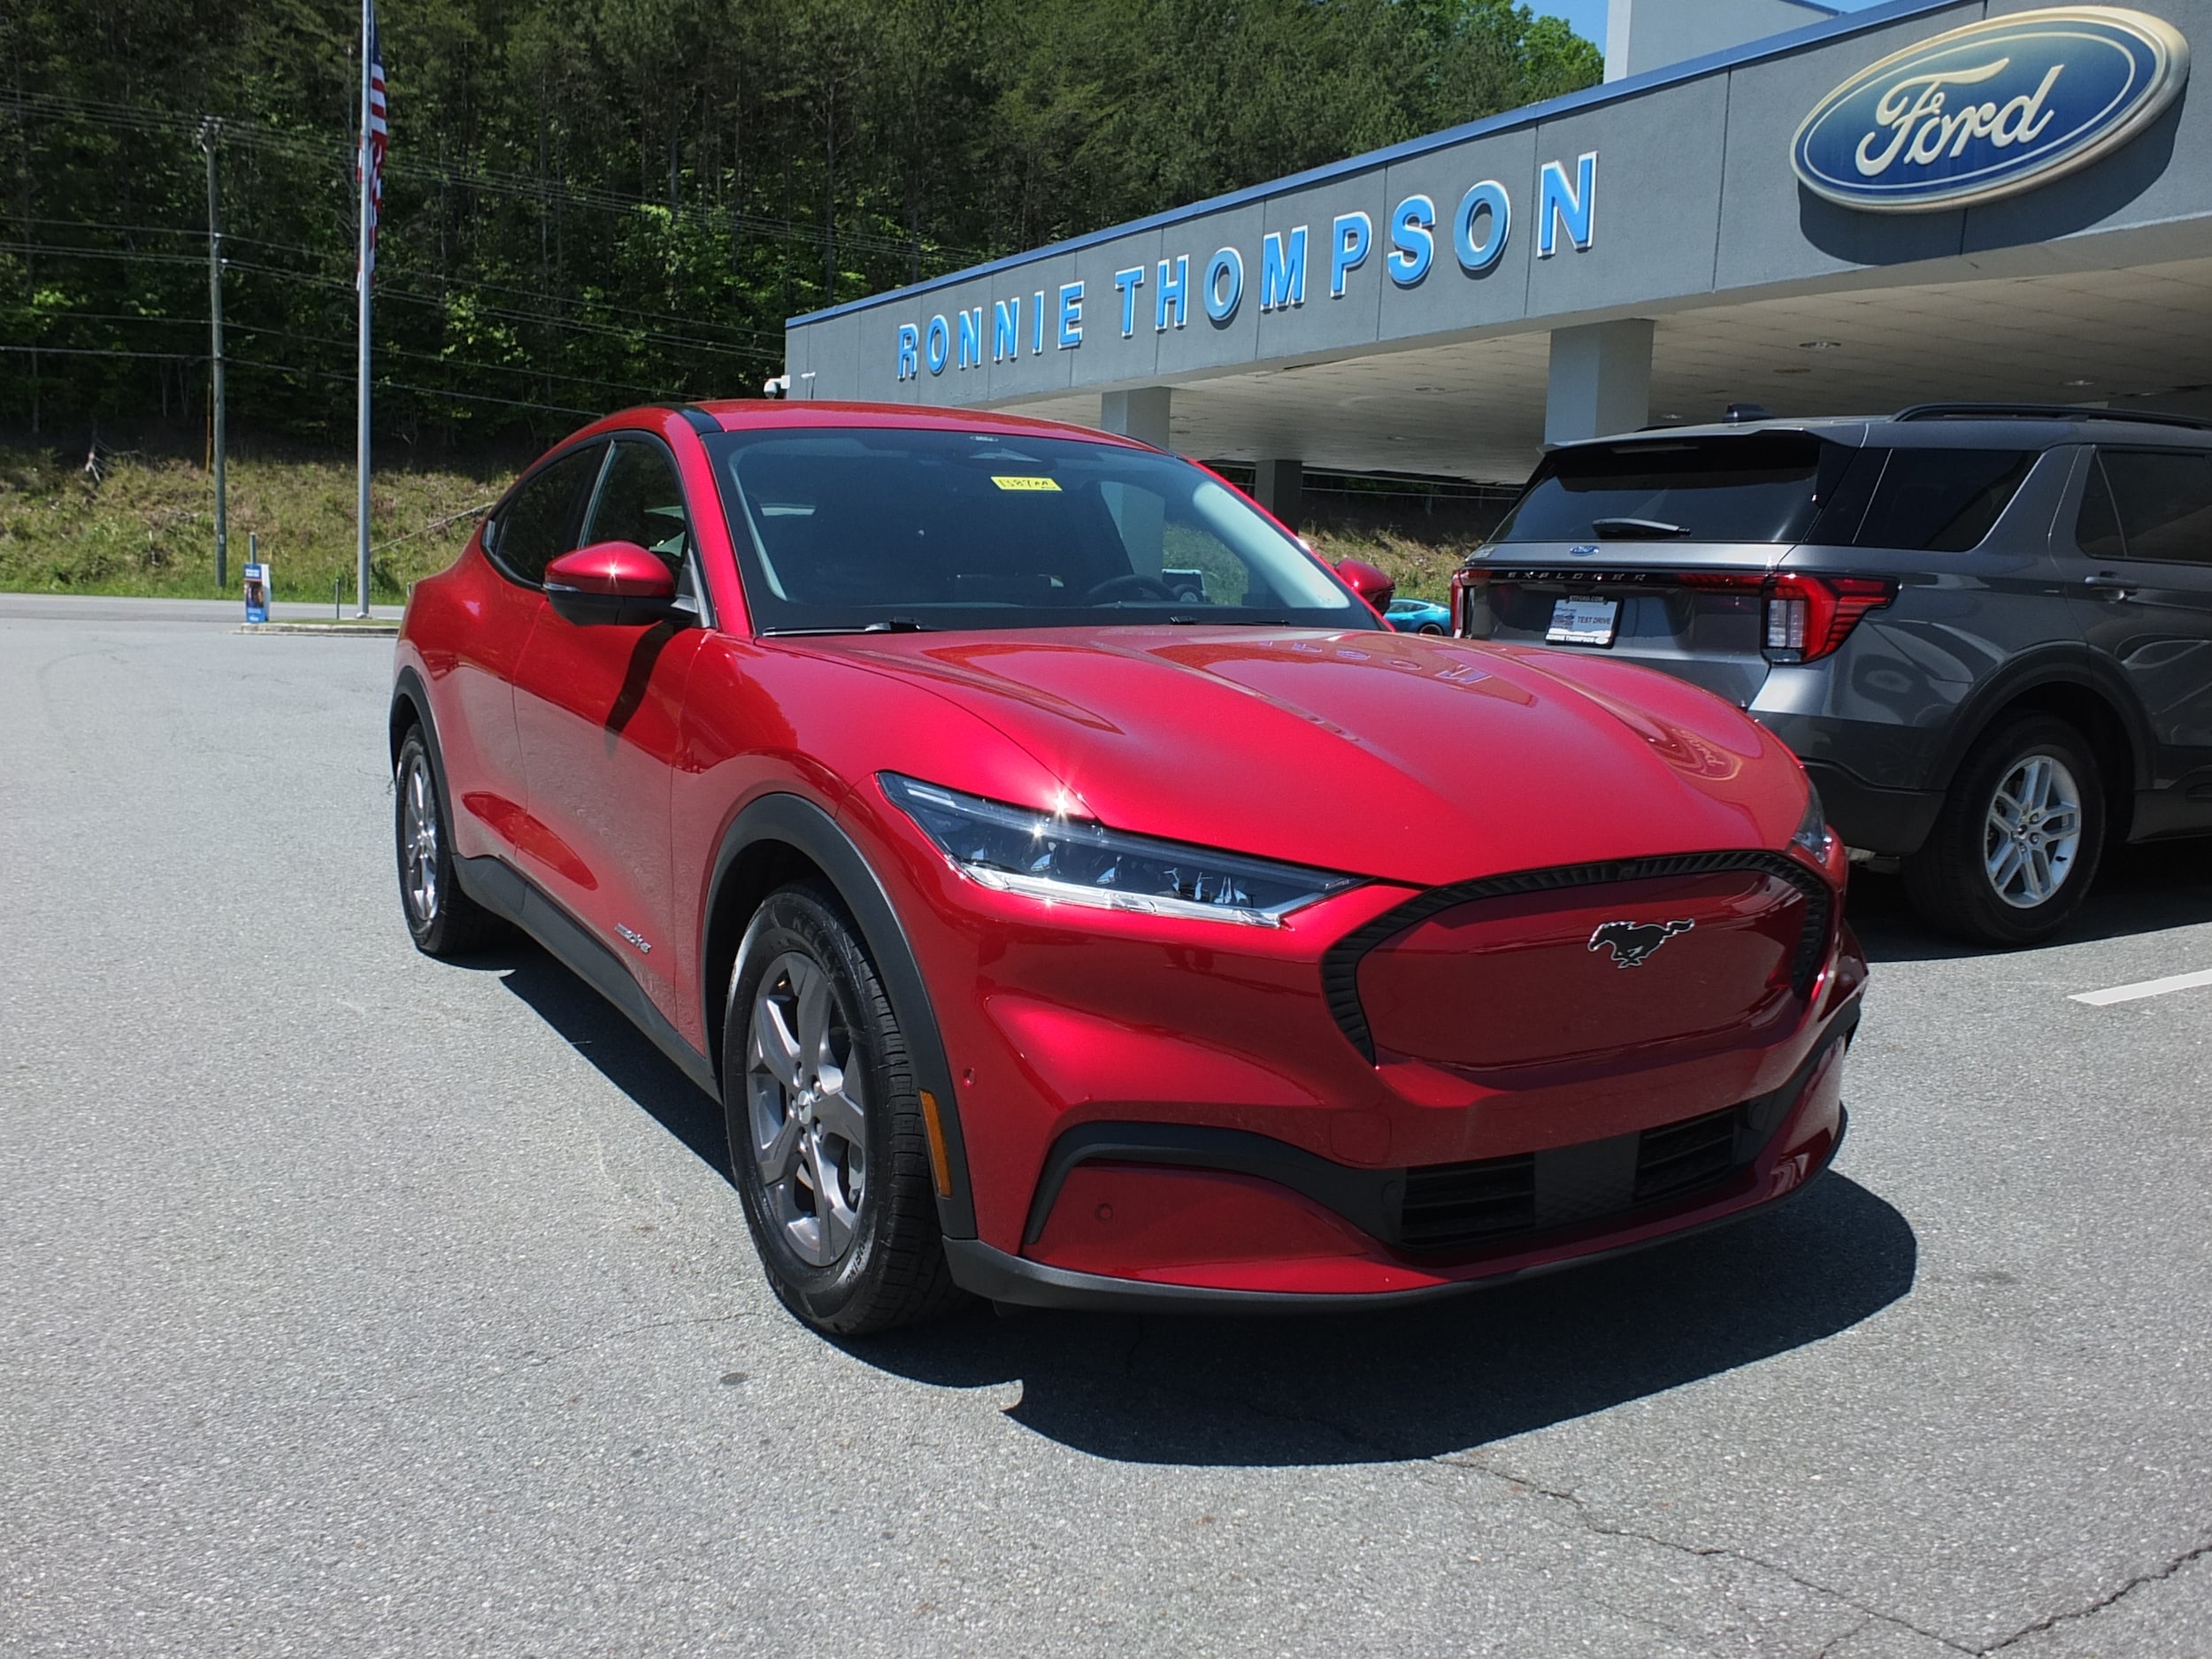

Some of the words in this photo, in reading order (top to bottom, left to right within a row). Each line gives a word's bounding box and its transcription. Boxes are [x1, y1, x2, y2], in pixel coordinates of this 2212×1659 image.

[1855, 57, 2065, 177] Ford
[897, 280, 1086, 380] RONNIE
[1115, 150, 1599, 337] THOMPSON
[1508, 572, 1646, 581] EXPLORER
